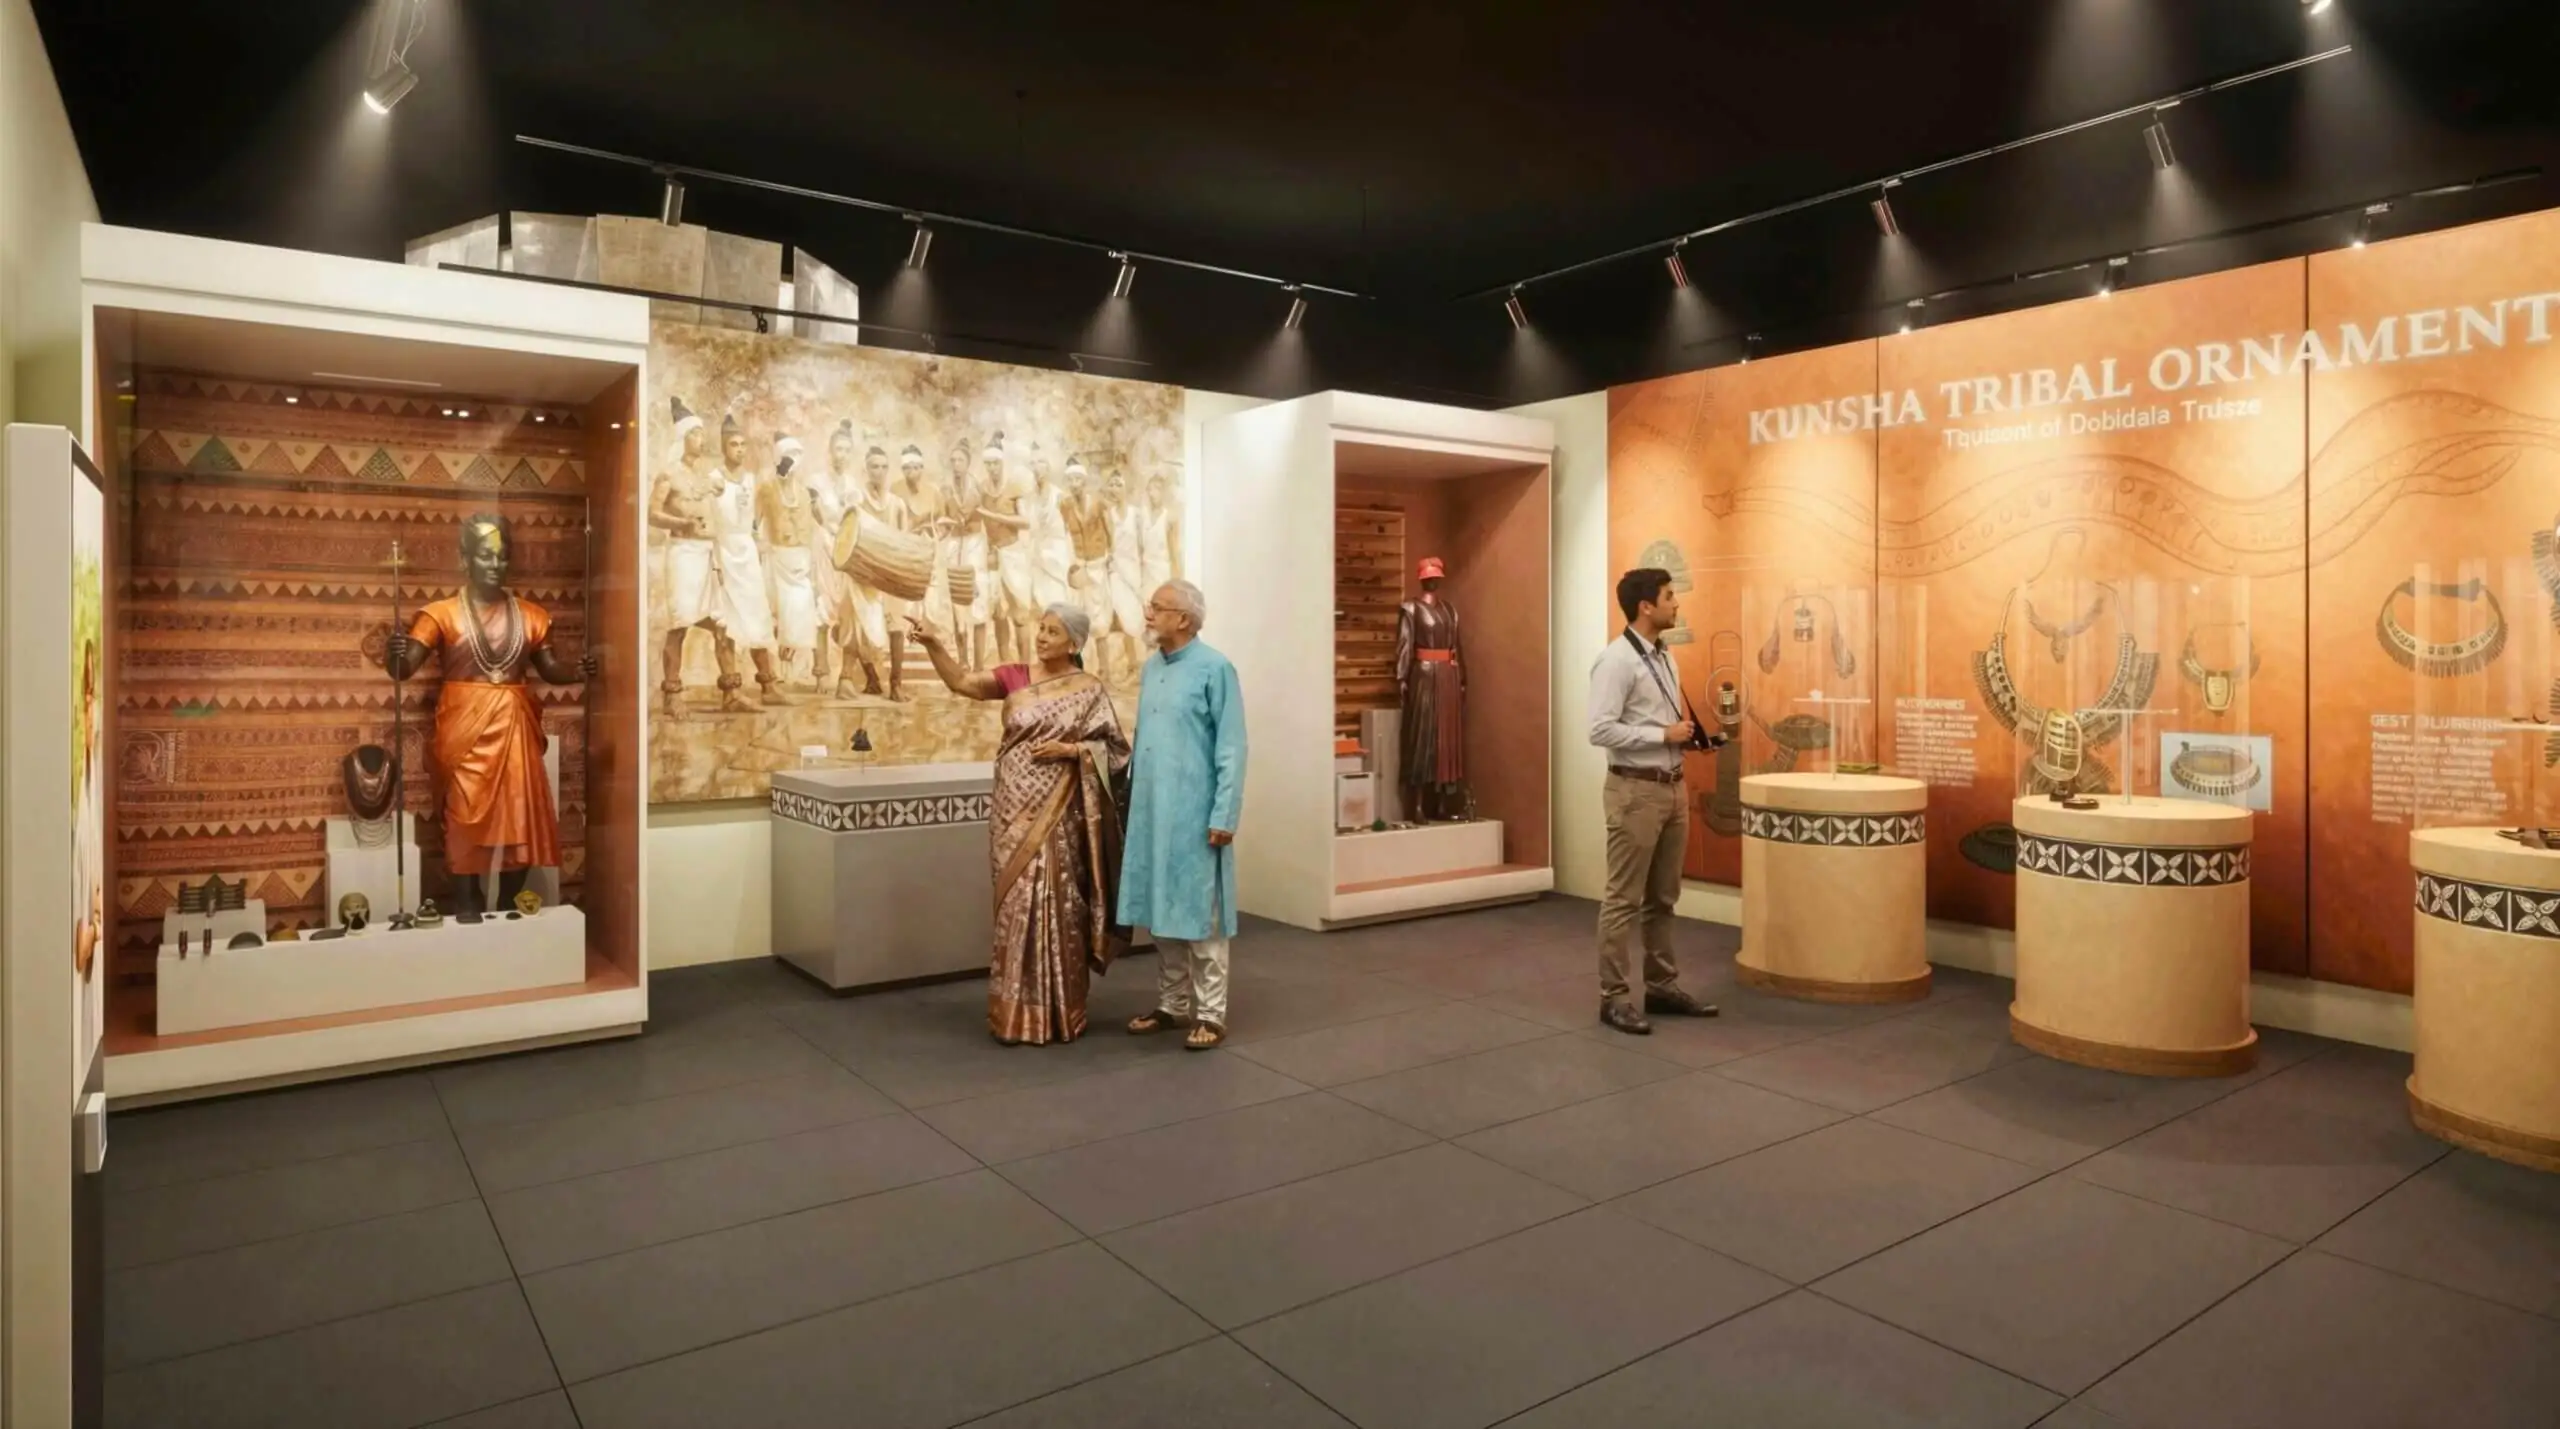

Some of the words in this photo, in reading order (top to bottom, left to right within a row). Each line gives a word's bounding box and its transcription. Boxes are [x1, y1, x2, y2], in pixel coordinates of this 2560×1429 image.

[1748, 388, 1927, 445] KUNSHA
[1938, 357, 2133, 421] TRIBAL
[2148, 291, 2560, 392] ORNAMENT
[2039, 415, 2061, 438] of
[2069, 405, 2171, 435] Dobidala
